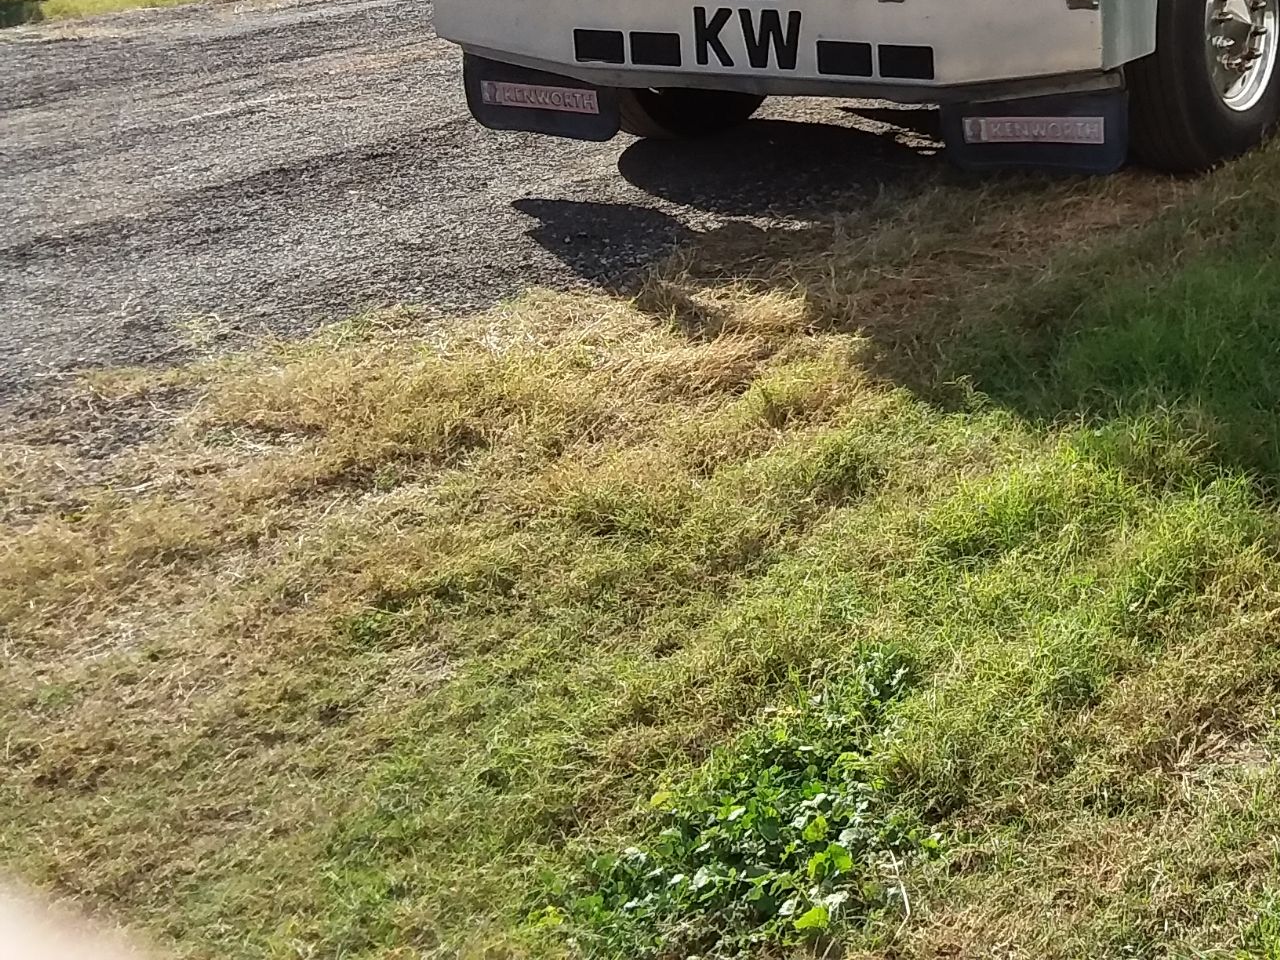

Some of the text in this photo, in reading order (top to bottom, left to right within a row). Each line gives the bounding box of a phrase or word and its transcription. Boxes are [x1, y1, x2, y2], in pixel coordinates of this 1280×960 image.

[693, 6, 802, 70] KW
[502, 86, 595, 110] KENWORTH
[991, 121, 1100, 139] KENWORTH
